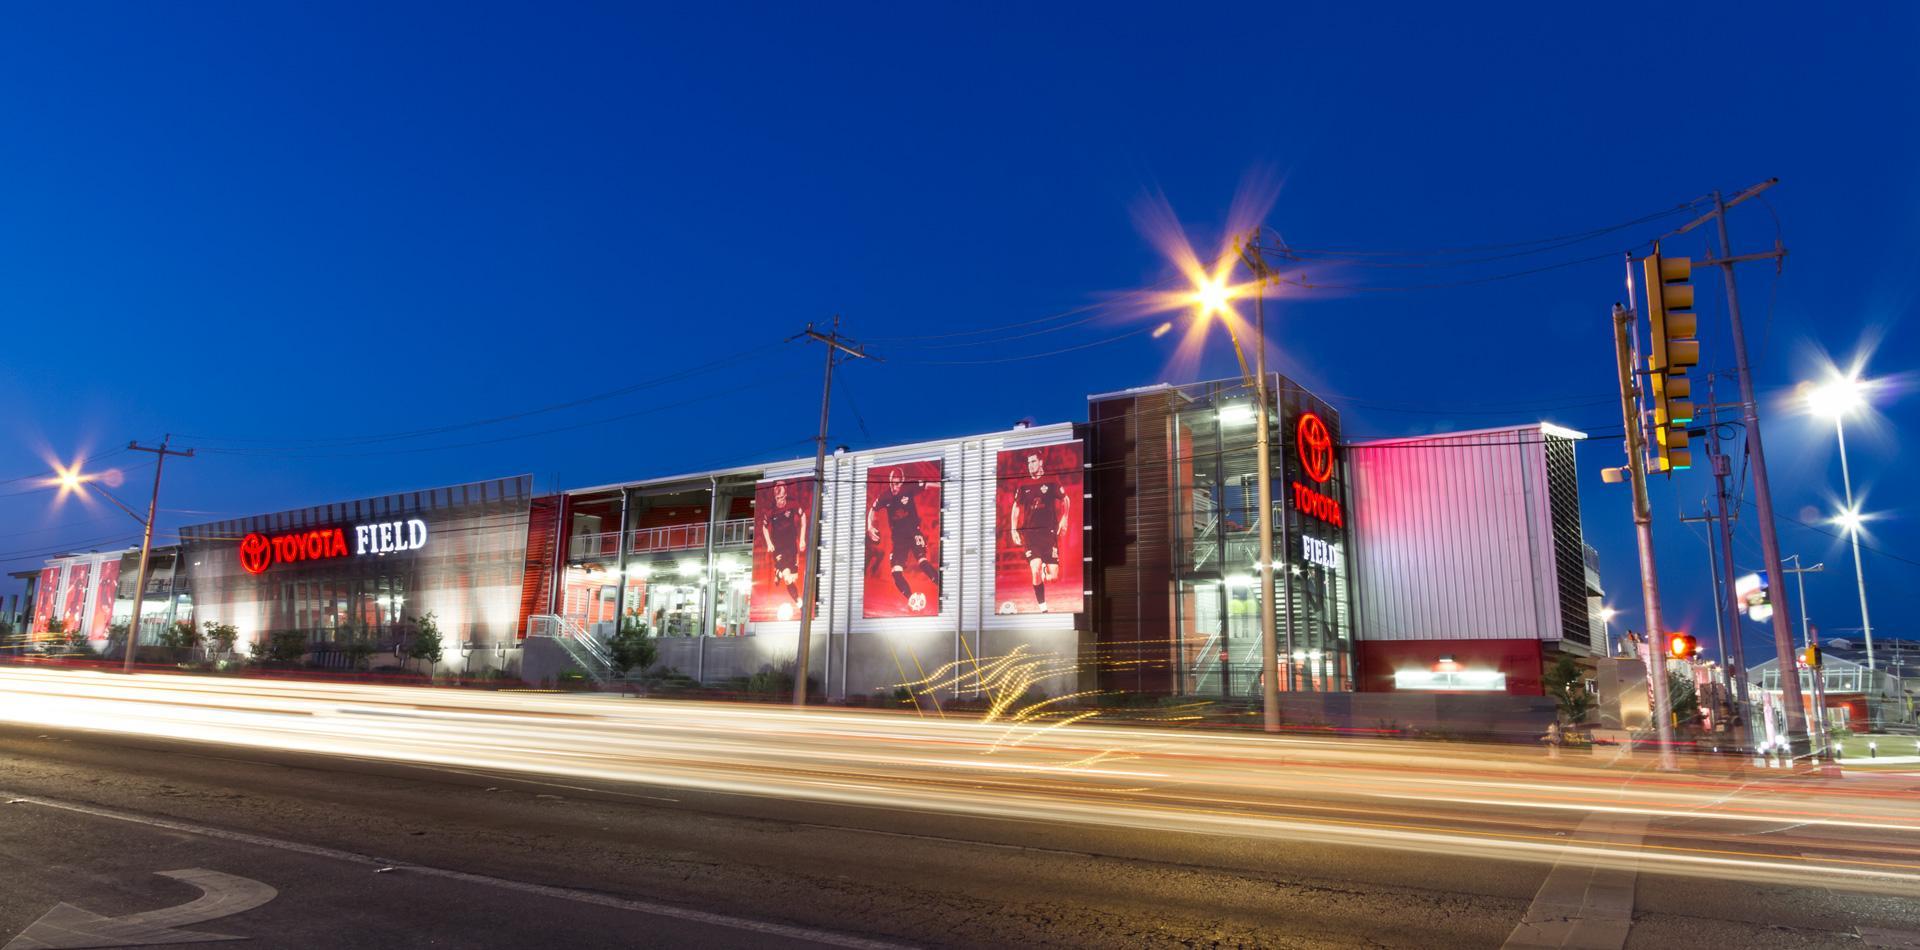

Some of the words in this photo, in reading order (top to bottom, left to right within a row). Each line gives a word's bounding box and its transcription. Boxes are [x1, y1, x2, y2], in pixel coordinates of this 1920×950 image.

[1292, 481, 1343, 529] TOYOTA
[272, 527, 348, 563] TOYOTA
[355, 519, 427, 554] FIELD
[1302, 534, 1336, 568] FIELD
